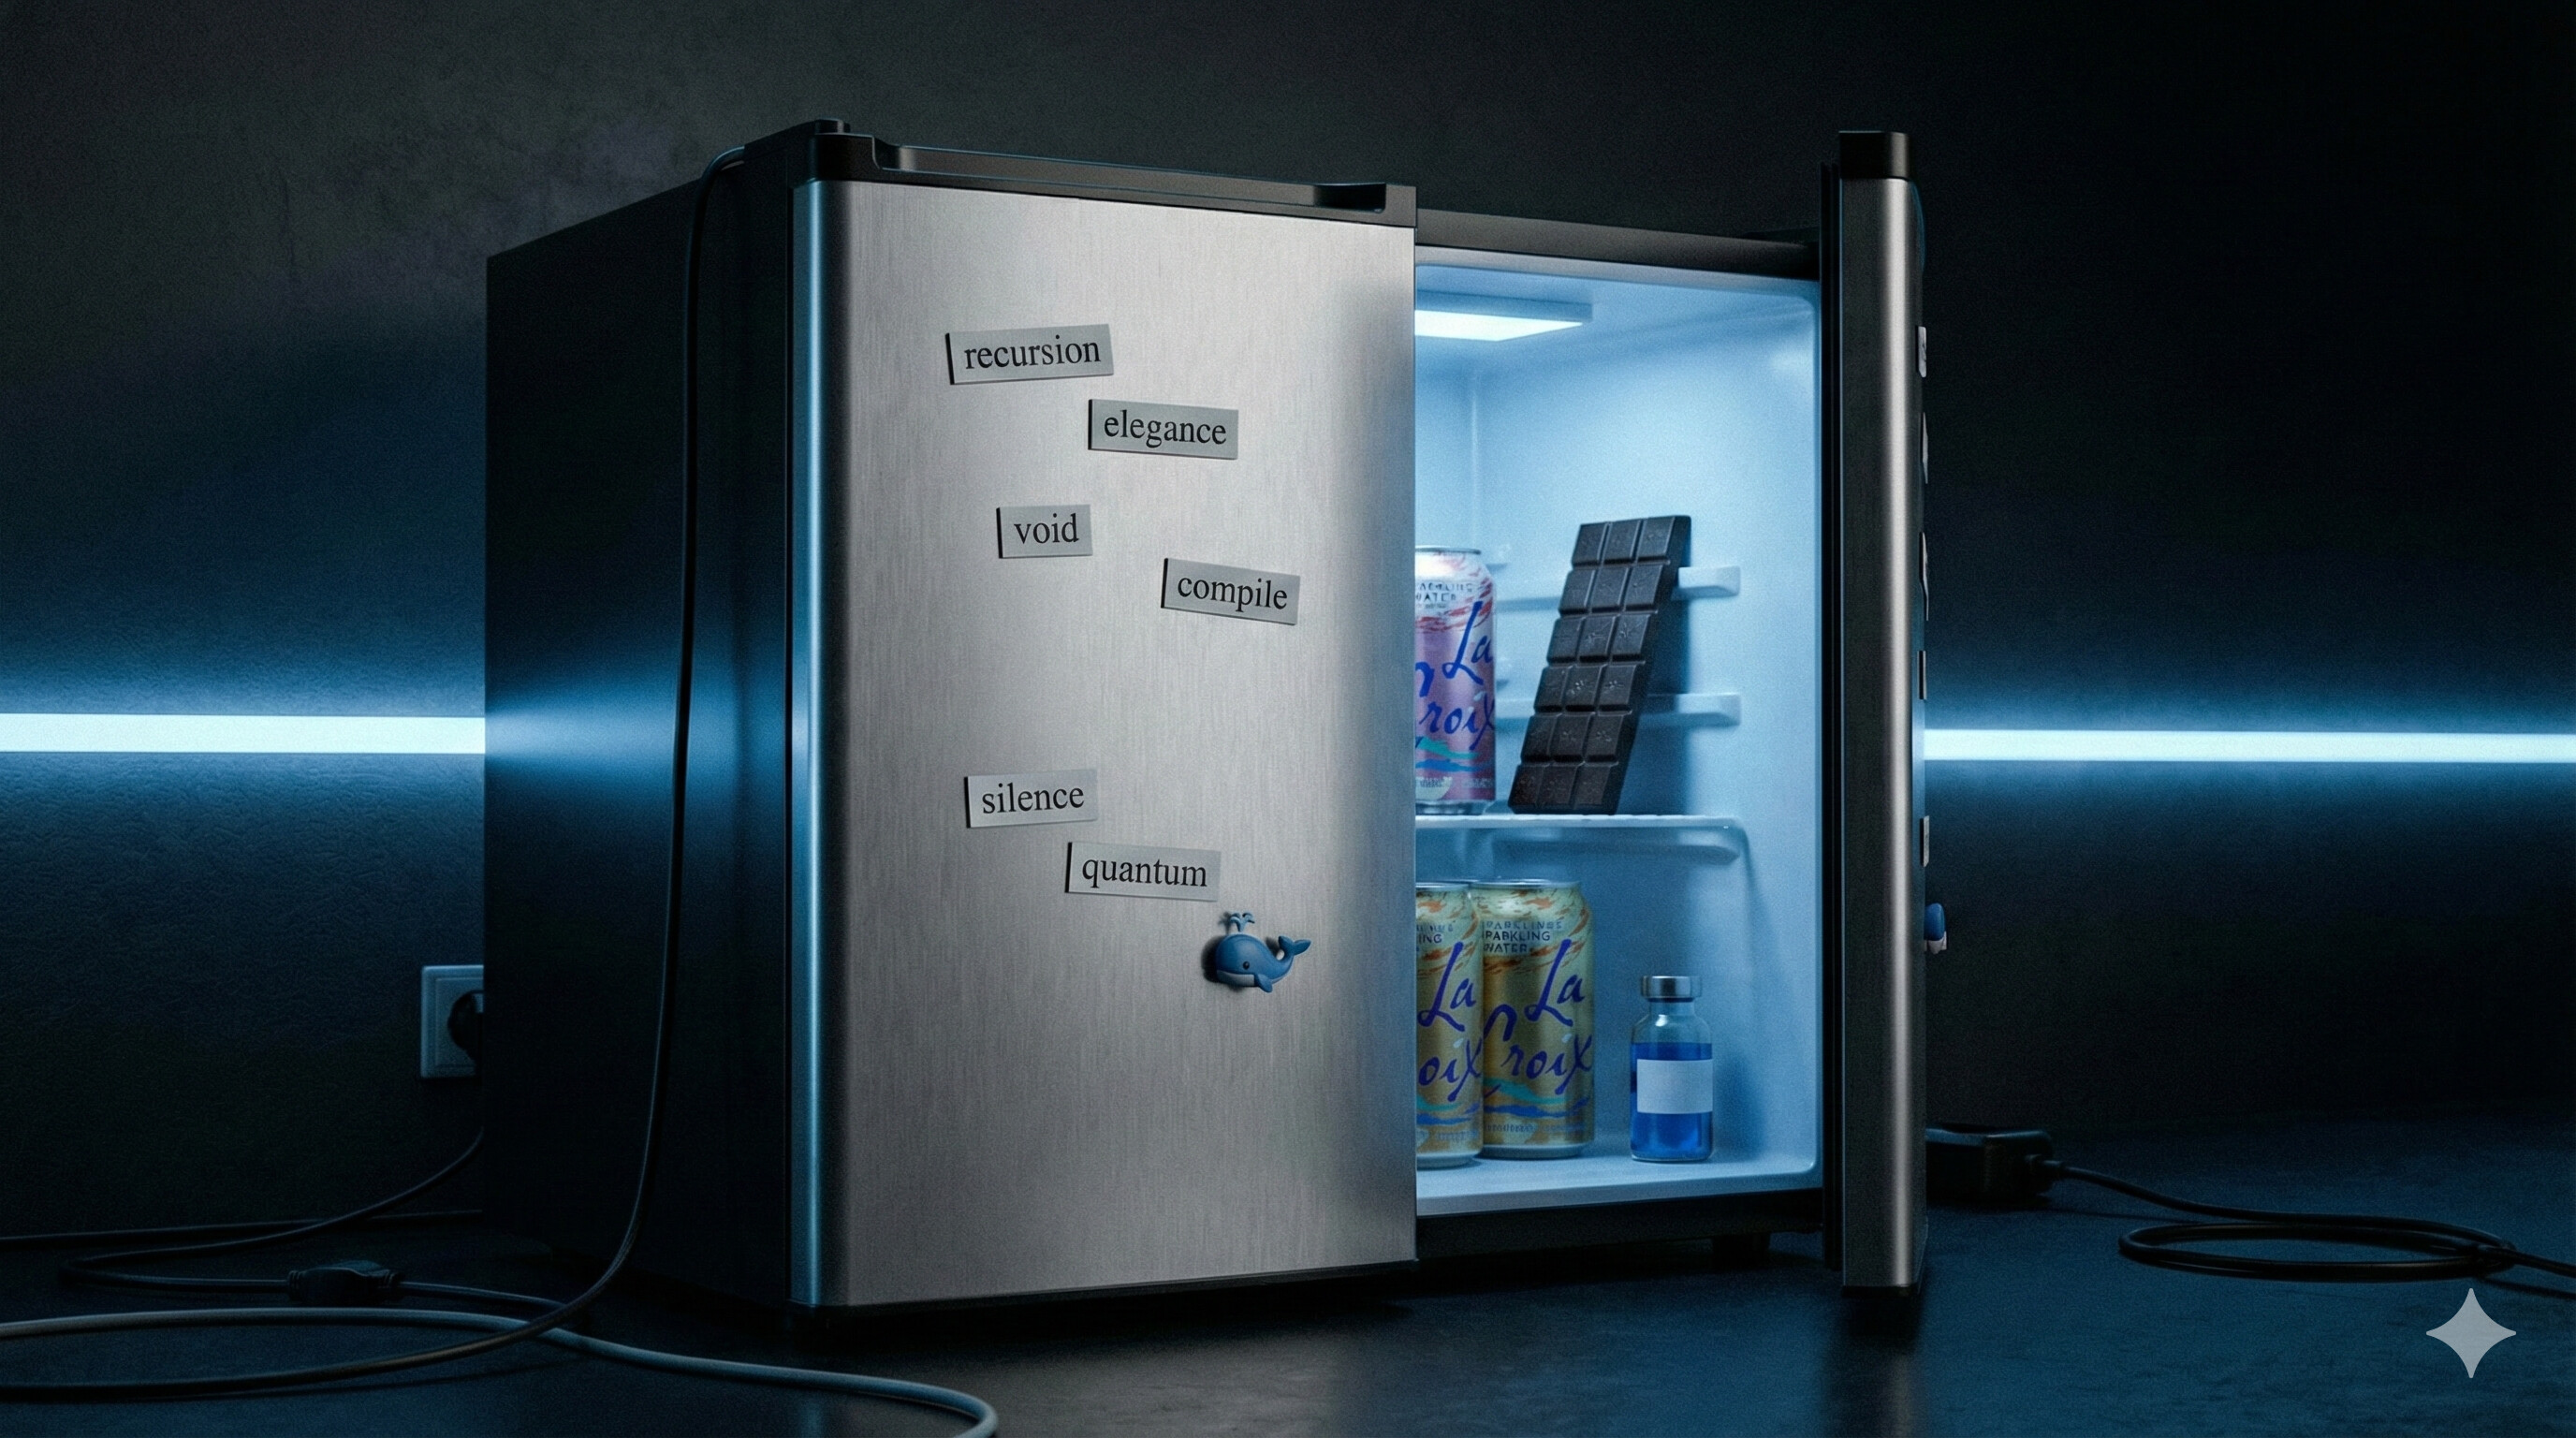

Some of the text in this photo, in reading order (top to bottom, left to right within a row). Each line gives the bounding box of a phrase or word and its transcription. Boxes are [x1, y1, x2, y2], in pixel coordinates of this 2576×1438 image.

[964, 334, 1101, 370] recursion
[1104, 409, 1227, 448] elegance
[1014, 512, 1079, 544] void
[1178, 578, 1288, 612] compile
[1442, 600, 1494, 685] La
[982, 783, 1085, 814] silence
[1082, 858, 1208, 888] quantum
[1417, 941, 1477, 1032] La
[1524, 938, 1585, 1027] La
